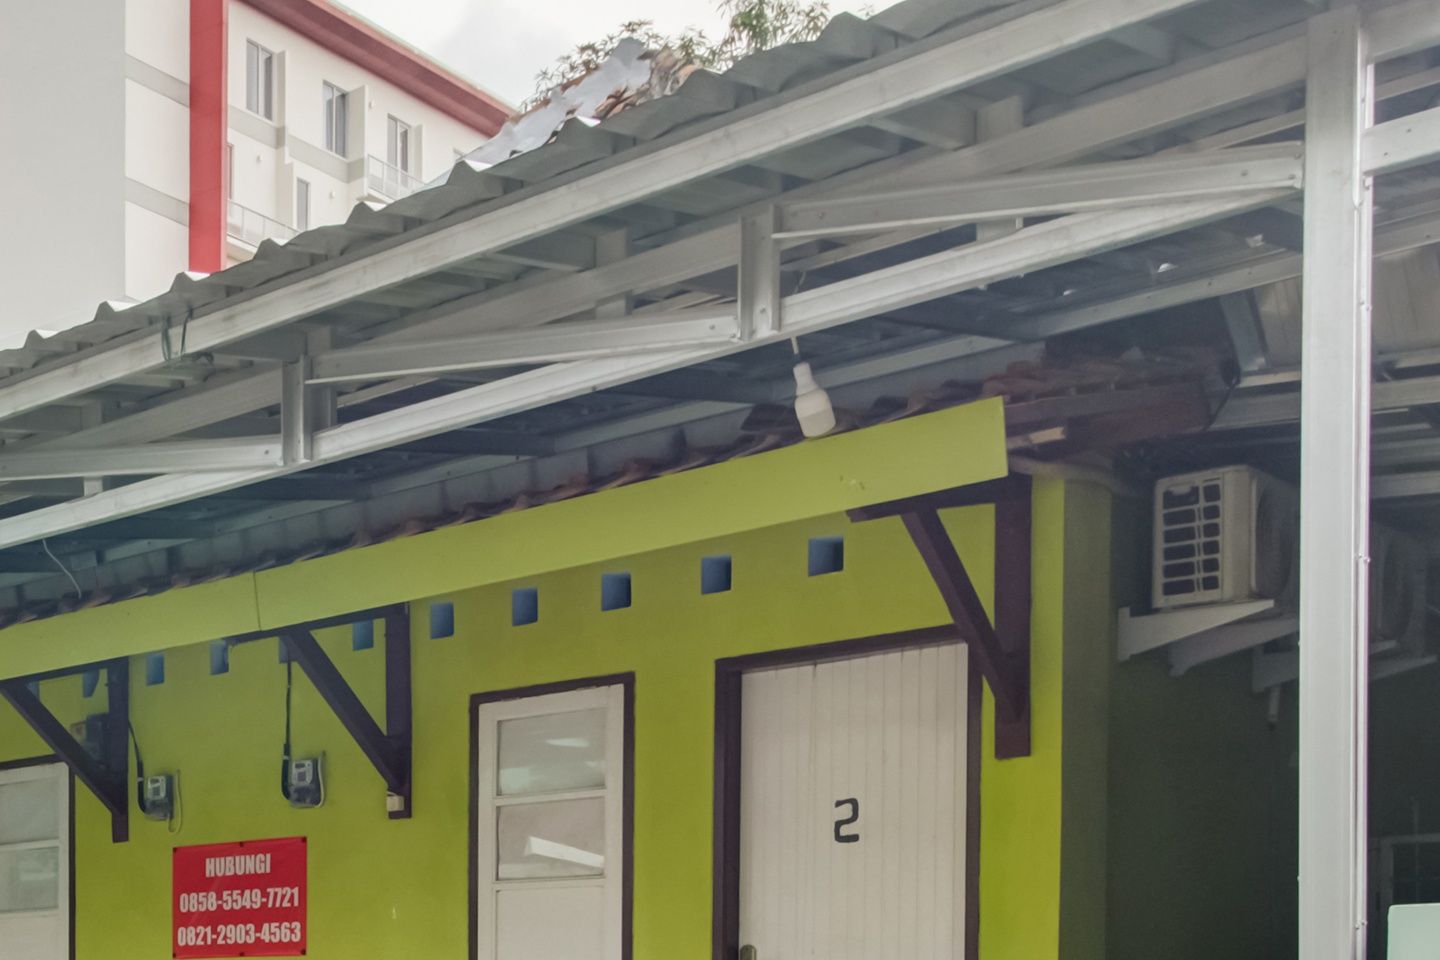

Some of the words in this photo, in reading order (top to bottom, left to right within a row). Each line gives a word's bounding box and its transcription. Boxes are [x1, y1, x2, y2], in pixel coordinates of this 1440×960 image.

[834, 797, 860, 843] 2
[205, 853, 271, 878] HUBUNGI
[179, 886, 299, 913] 0858-5549-7721
[177, 921, 301, 946] 0821-2903-4563
